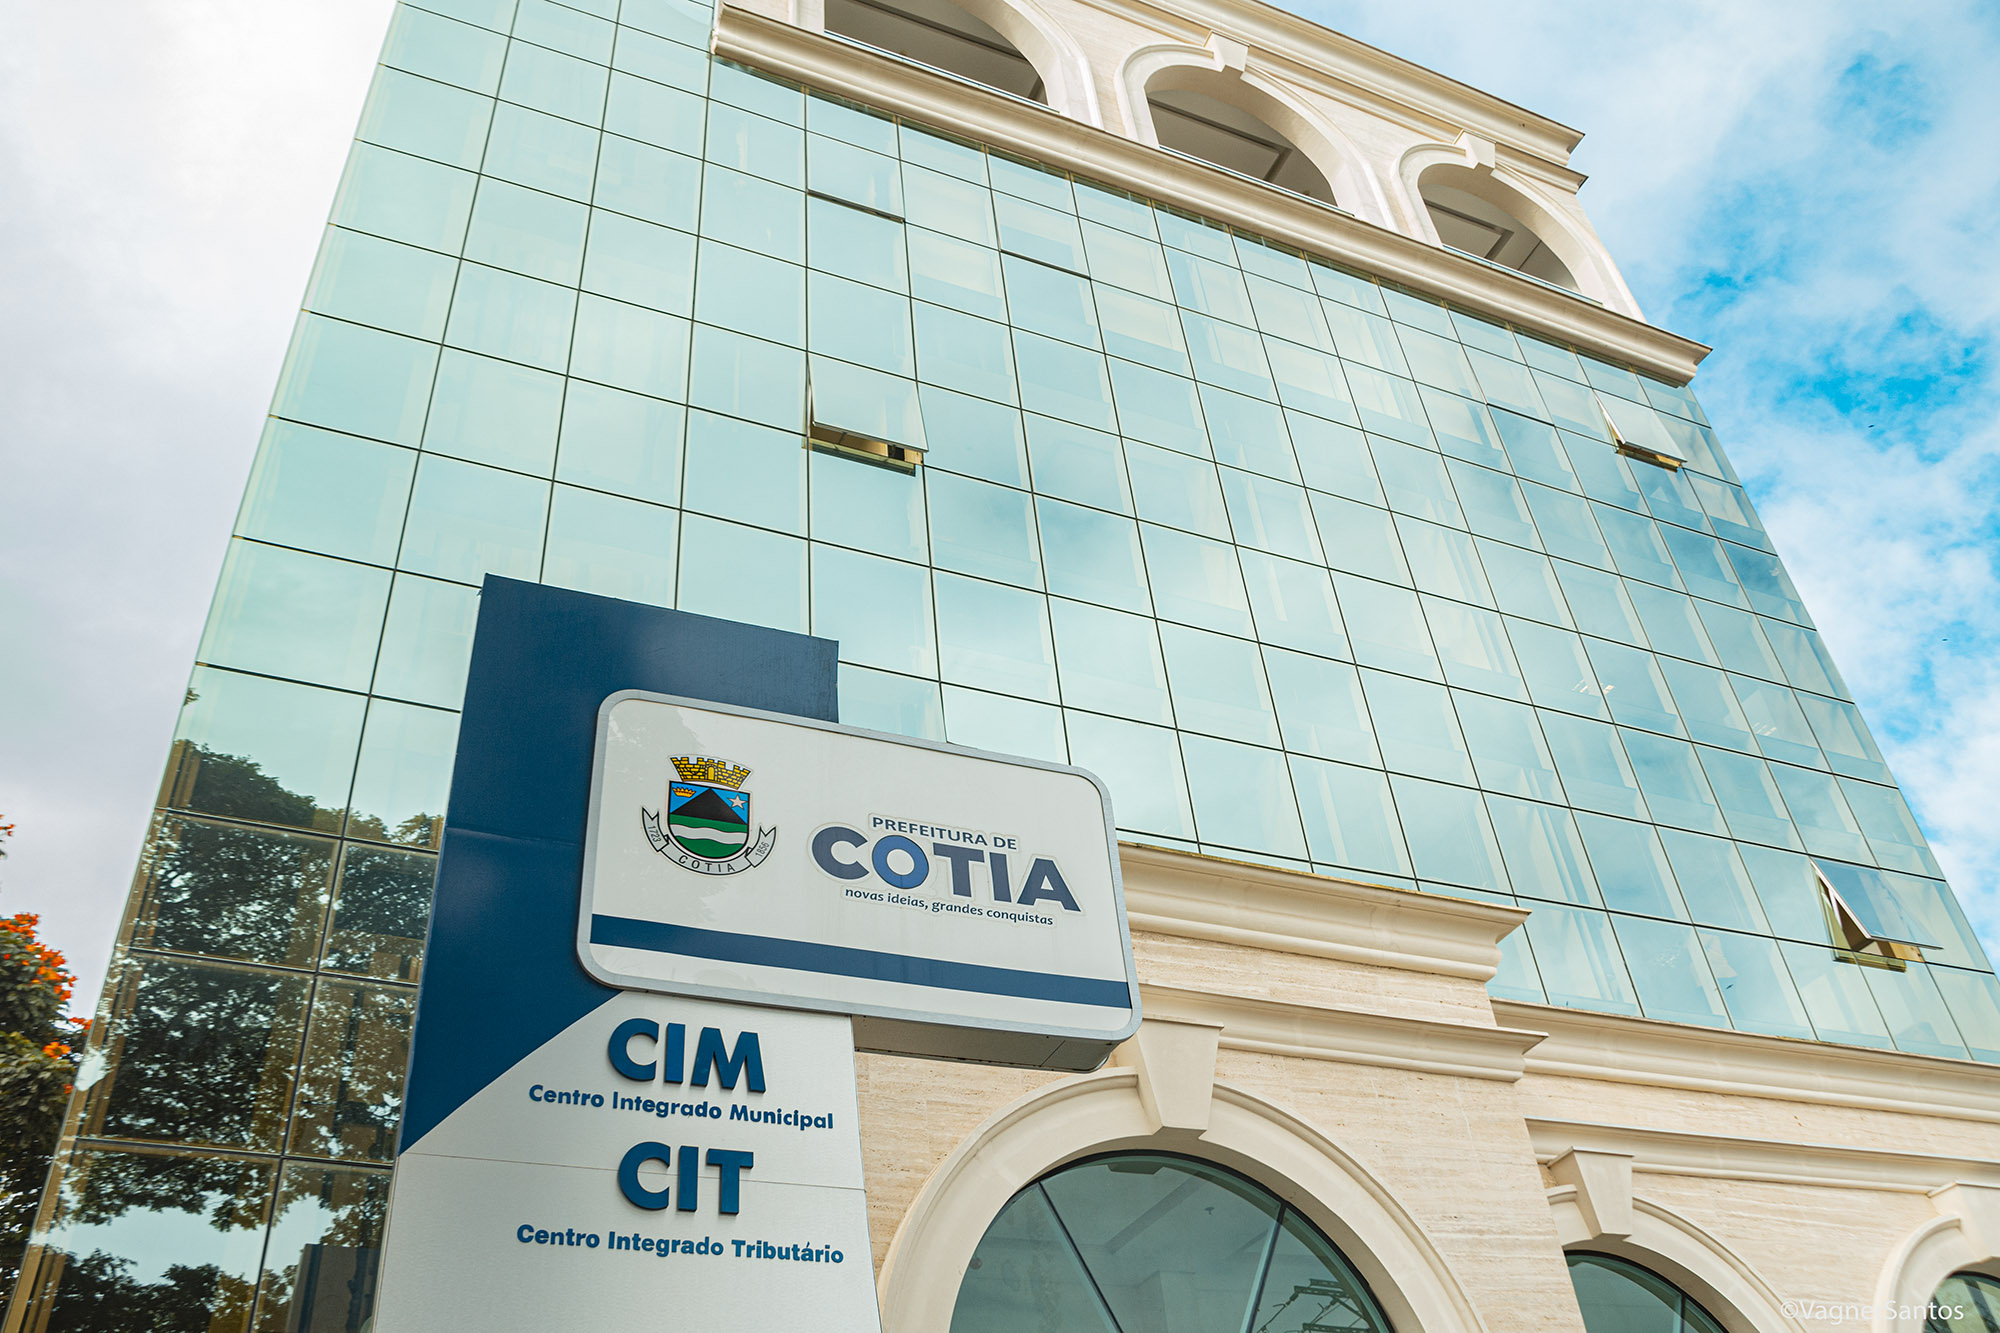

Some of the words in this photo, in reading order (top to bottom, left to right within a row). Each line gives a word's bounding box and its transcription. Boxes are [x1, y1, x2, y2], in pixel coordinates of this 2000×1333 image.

[647, 825, 662, 843] 1723
[754, 841, 770, 858] 1856
[872, 816, 988, 846] PREFEITURA
[993, 836, 1017, 850] DE
[678, 854, 736, 873] COTIA
[811, 826, 1082, 912] COTIA
[845, 888, 884, 902] novas
[887, 892, 929, 910] ideias,
[931, 901, 983, 916] grandes
[986, 908, 1054, 926] conquistas
[608, 1017, 766, 1094] CIM
[528, 1084, 605, 1108] Centro
[613, 1091, 722, 1120] Integrado
[729, 1103, 834, 1131] Municipal
[618, 1141, 754, 1215] CIT
[516, 1224, 600, 1249] Centro
[608, 1231, 724, 1257] Integrado
[731, 1239, 844, 1264] Tributário
